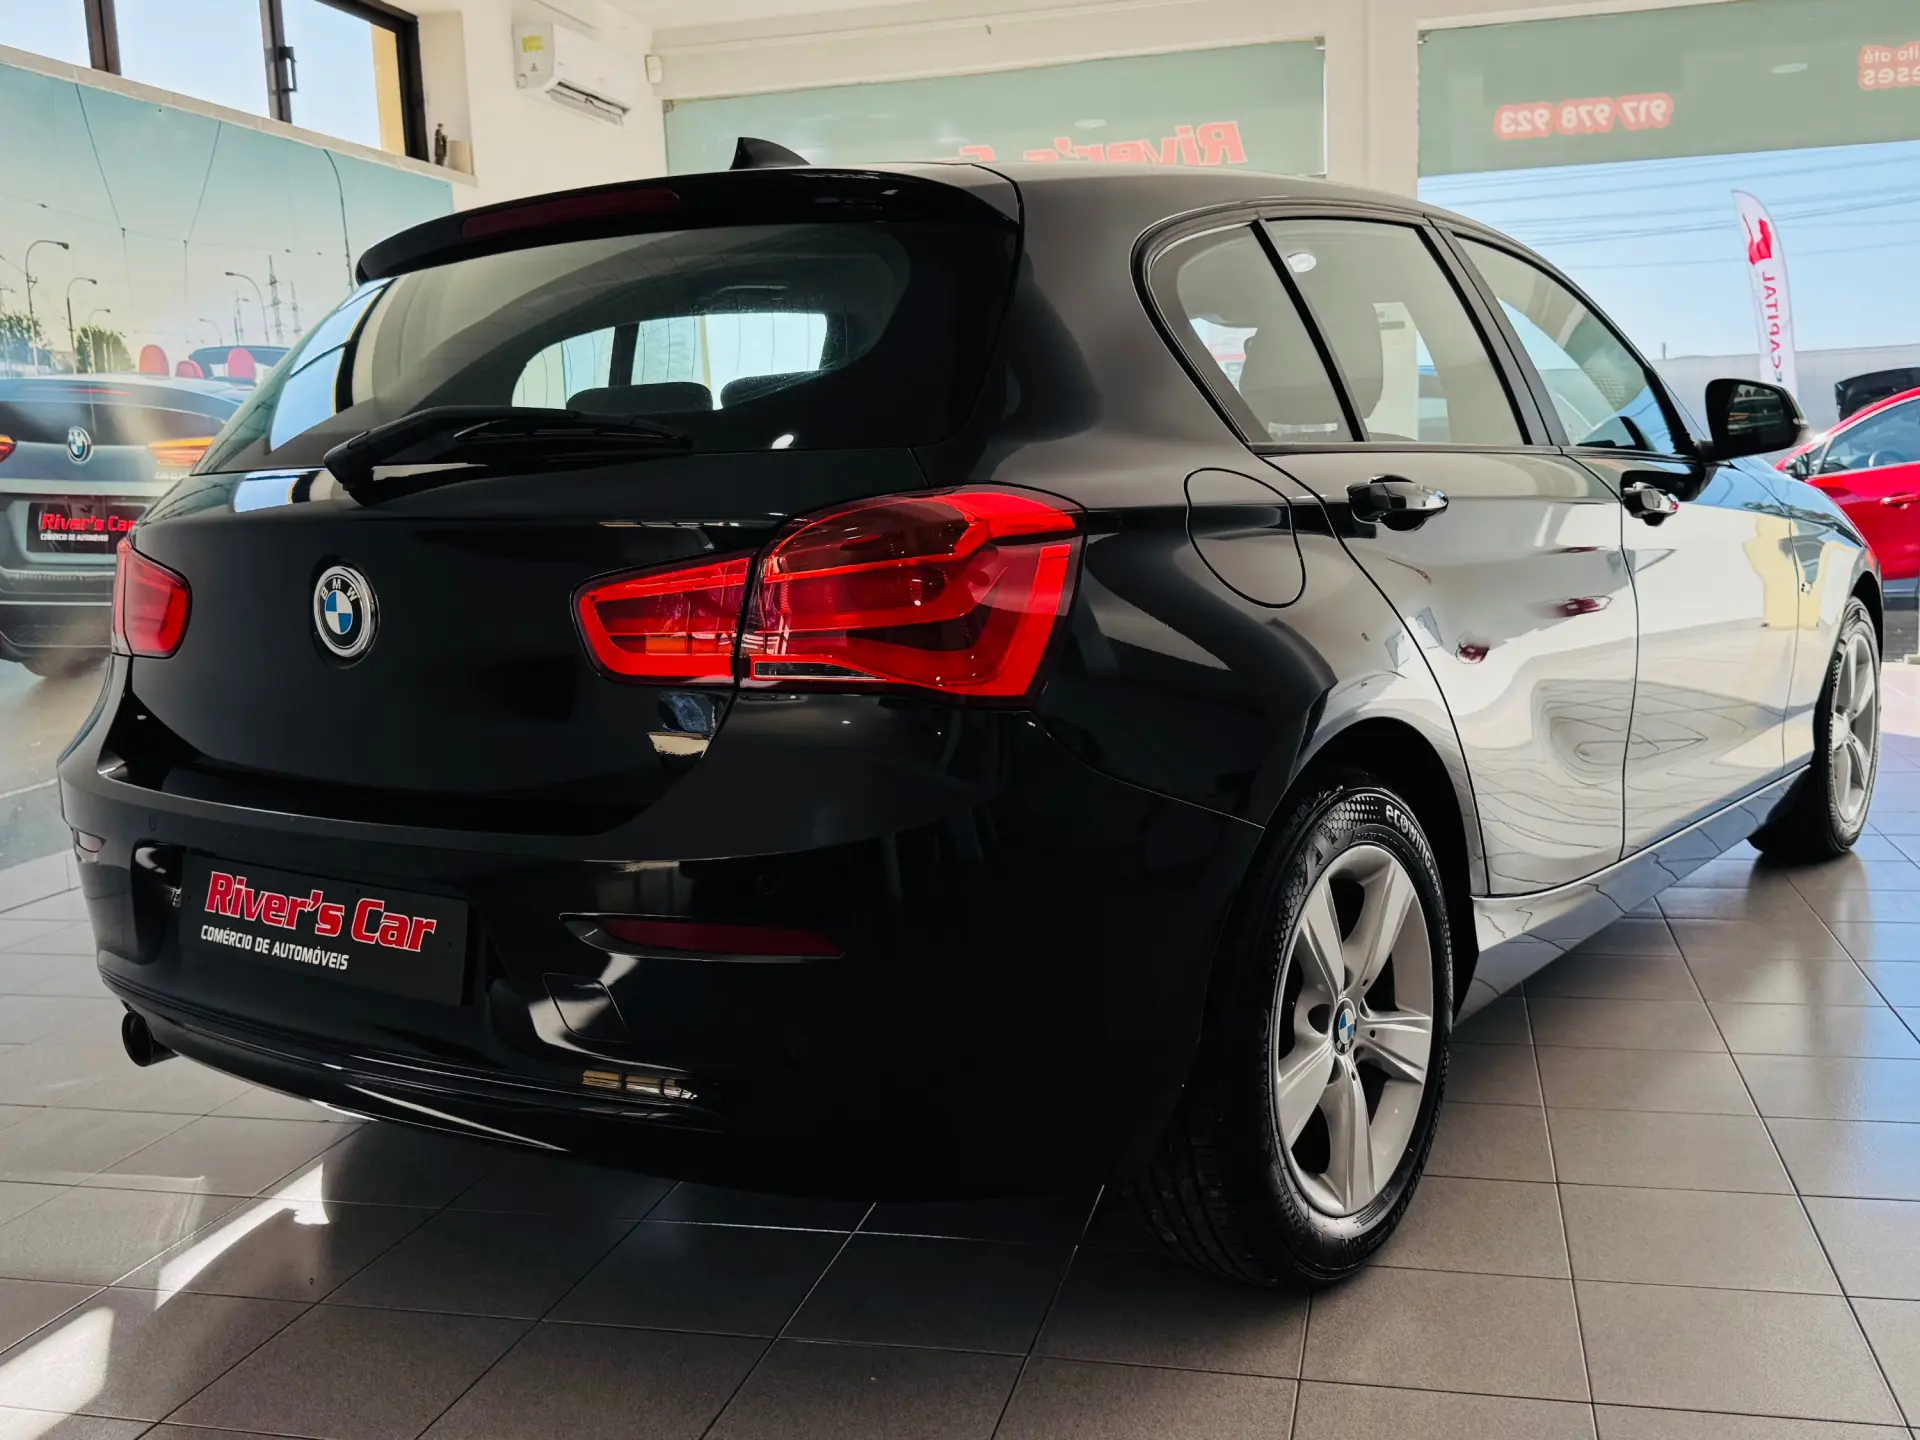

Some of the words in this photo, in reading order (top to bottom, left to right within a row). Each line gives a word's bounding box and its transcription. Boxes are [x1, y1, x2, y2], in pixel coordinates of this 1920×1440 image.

[40, 512, 105, 532] River's
[320, 578, 358, 602] BMW
[204, 871, 345, 937] River's
[351, 897, 437, 952] Car
[201, 924, 252, 950] COMÉRCIO
[254, 939, 271, 955] DE
[271, 942, 350, 971] AUTOMÓVEIS
